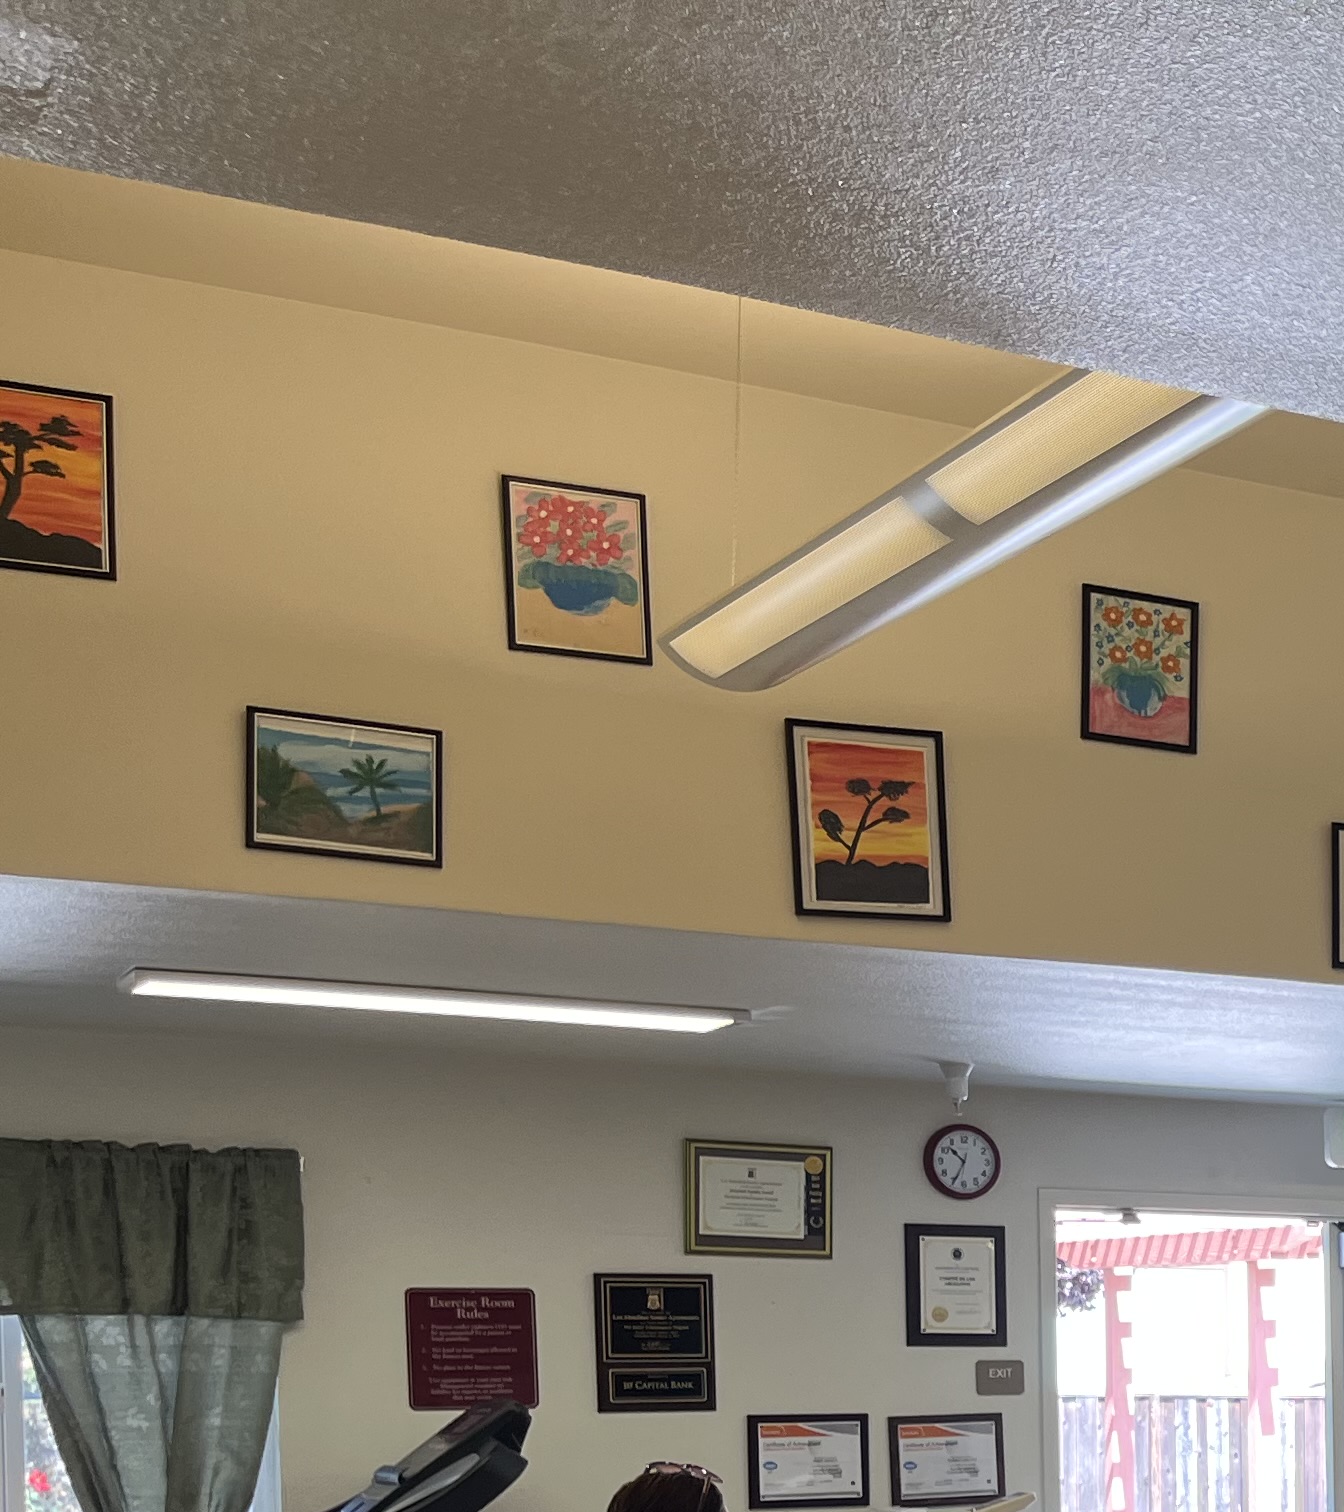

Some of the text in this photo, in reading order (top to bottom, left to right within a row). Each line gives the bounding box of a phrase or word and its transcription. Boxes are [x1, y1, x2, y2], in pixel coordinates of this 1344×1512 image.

[960, 1135, 969, 1144] 12
[980, 1147, 987, 1156] 2
[937, 1156, 944, 1166] 9
[983, 1158, 991, 1167] 3
[941, 1168, 948, 1178] 8
[980, 1169, 987, 1178] 4
[960, 1180, 968, 1189] 6
[429, 1296, 515, 1309] Exercise Room
[456, 1308, 490, 1320] Rules
[988, 1367, 1013, 1379] EXIT
[671, 1381, 695, 1391] BANK
